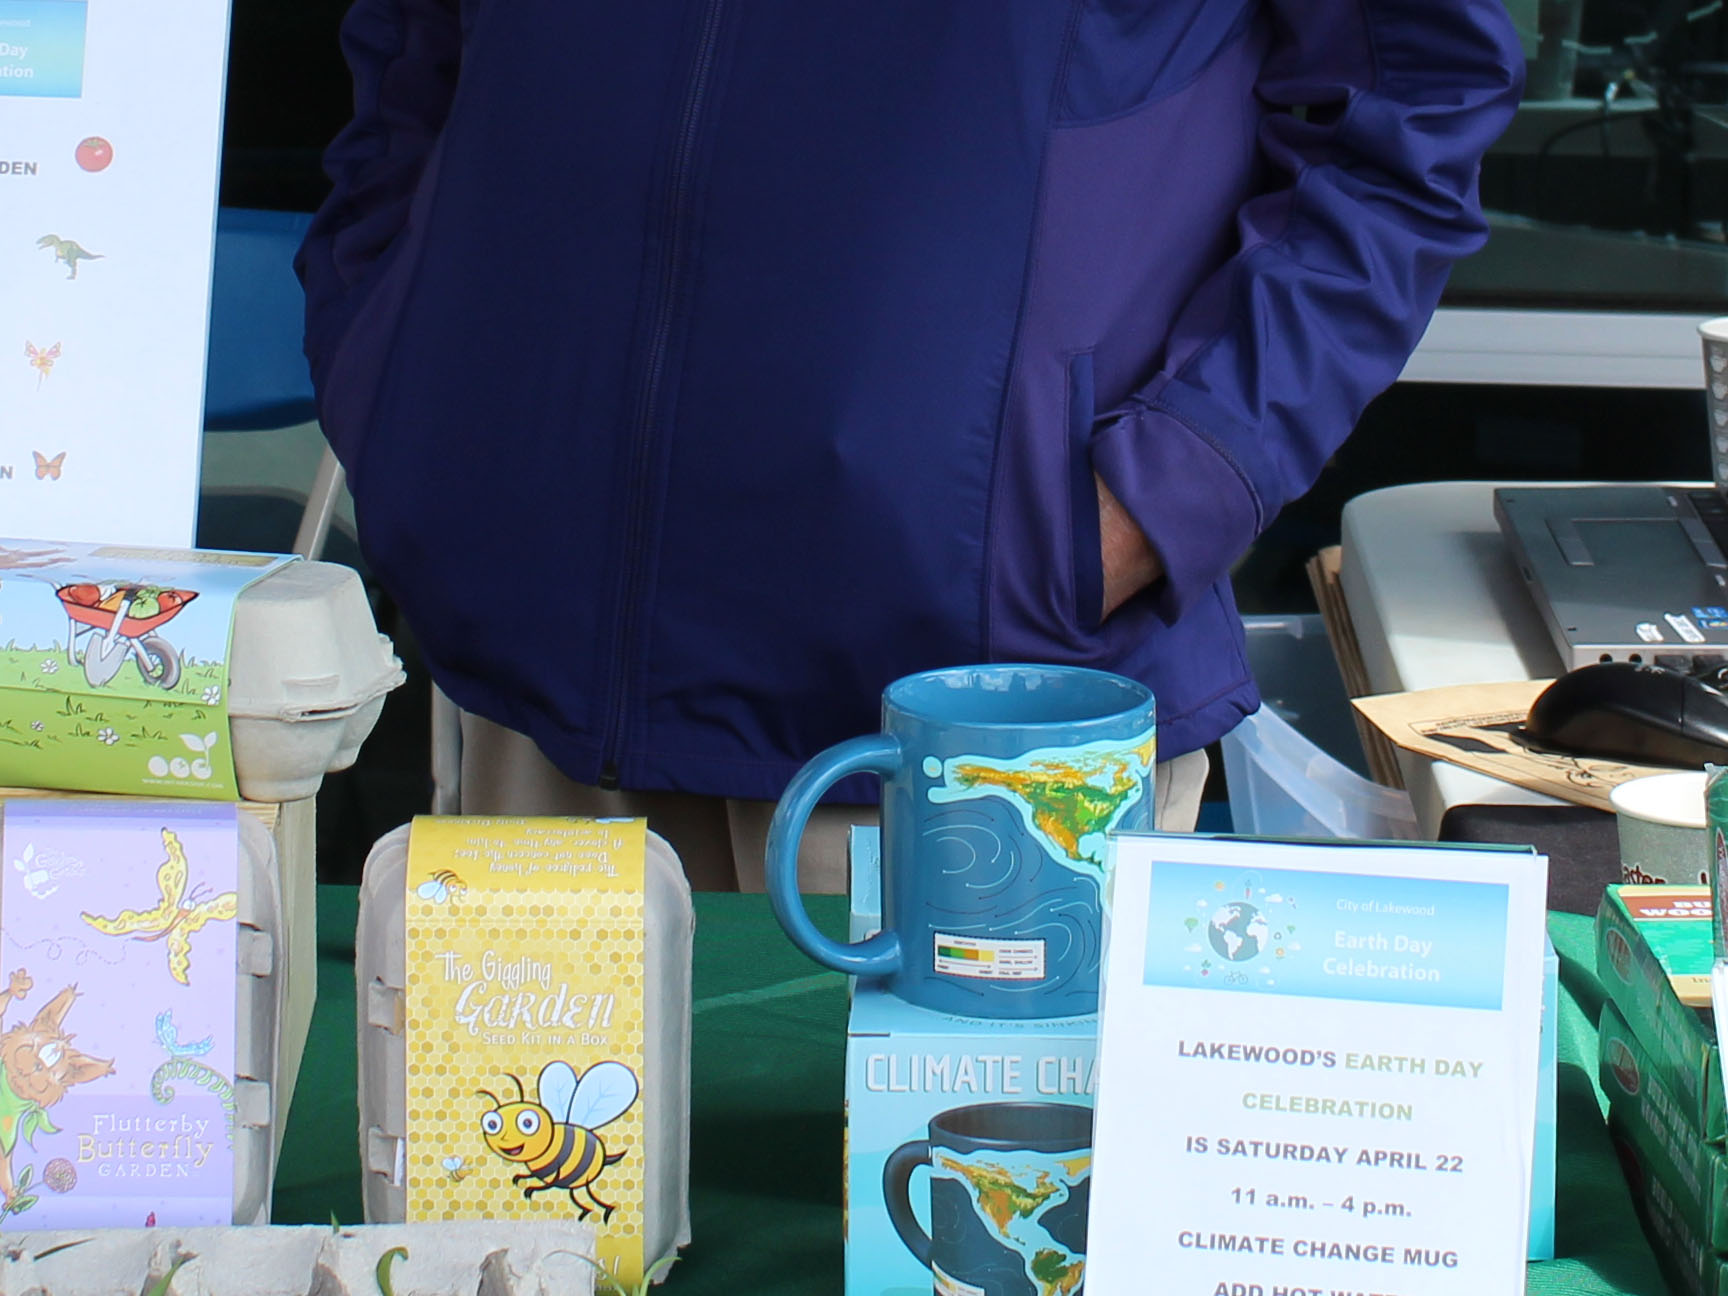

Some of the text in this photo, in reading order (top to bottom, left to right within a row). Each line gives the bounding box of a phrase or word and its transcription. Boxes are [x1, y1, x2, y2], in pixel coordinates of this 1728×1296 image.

[1336, 898, 1435, 917] City of Lakewood
[1334, 931, 1432, 958] Earth Day
[435, 950, 552, 988] The Giggling
[1323, 958, 1440, 982] Celebration
[865, 1054, 1023, 1094] CLIMATE
[1178, 1040, 1483, 1078] LAKEWOOD'S EARTH DAY
[1242, 1092, 1413, 1121] CELEBRATION
[93, 1113, 209, 1139] Flutterby
[77, 1133, 214, 1168] Butterfly
[1186, 1136, 1463, 1172] IS SATURDAY APRIL 22
[98, 1163, 189, 1177] GARDEN
[1231, 1188, 1412, 1218] 11 a.m. 4 p.m.
[1178, 1231, 1458, 1268] CLIMATE CHANGE MUG
